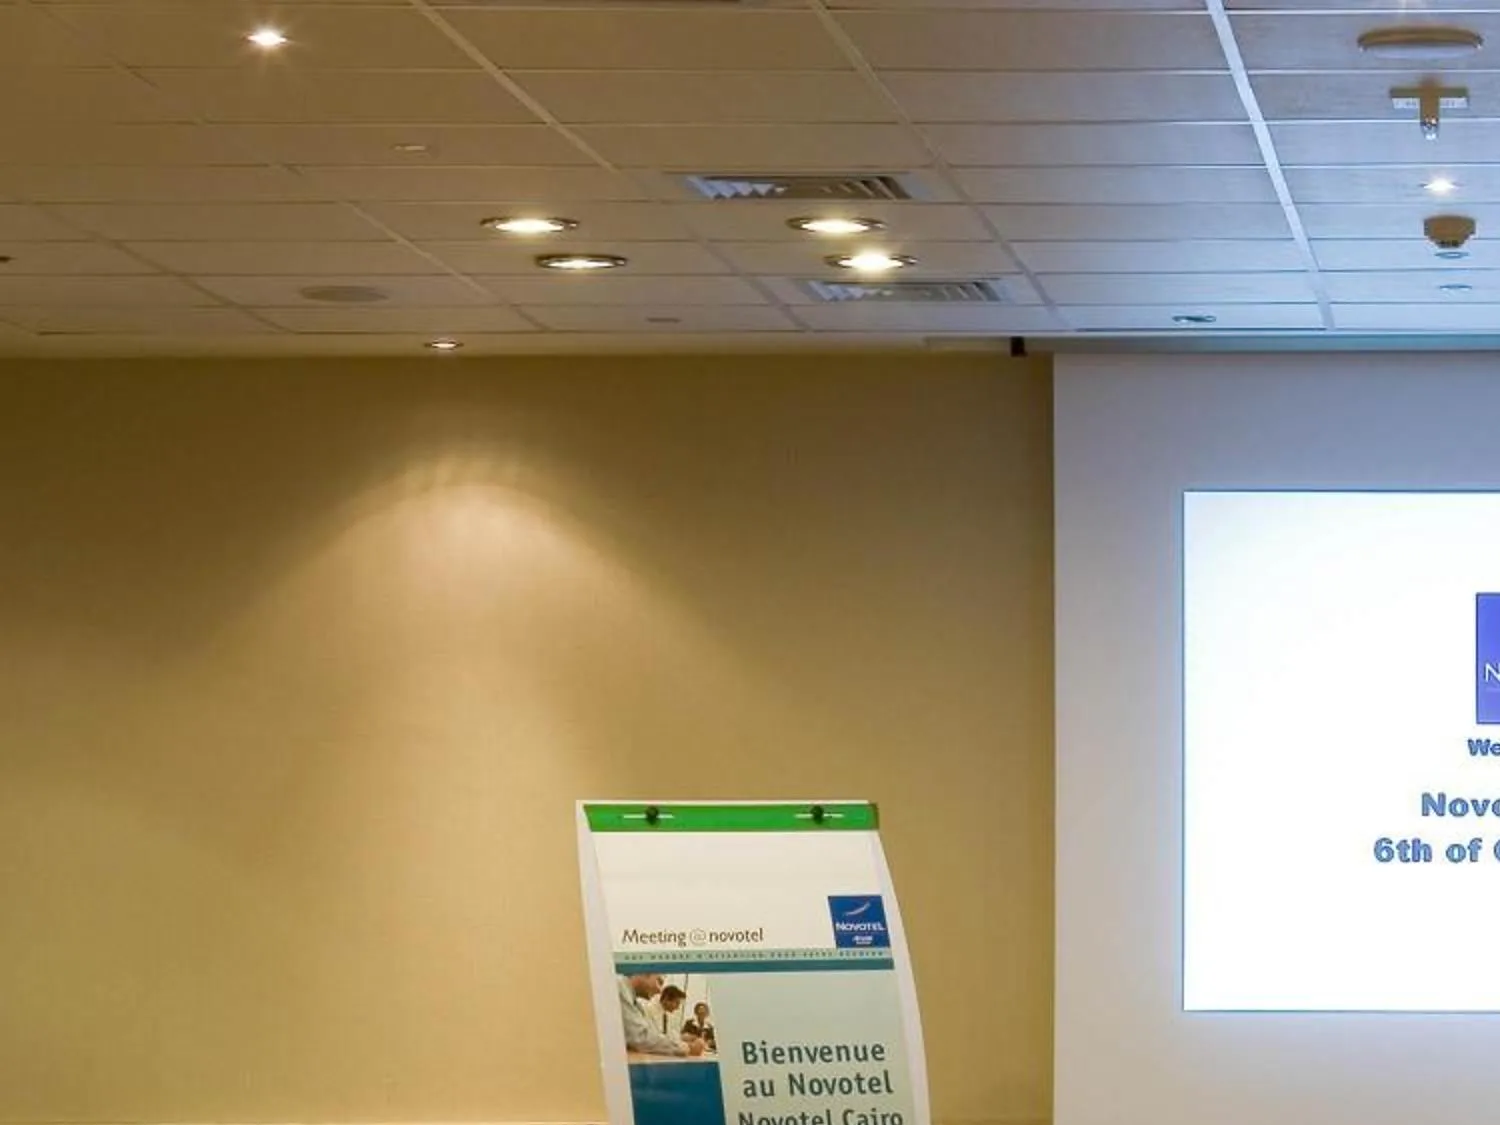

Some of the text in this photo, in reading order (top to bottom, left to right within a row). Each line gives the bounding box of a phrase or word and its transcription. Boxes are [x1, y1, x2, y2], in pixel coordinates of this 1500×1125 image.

[1373, 836, 1433, 864] 6th
[1445, 836, 1483, 864] of
[741, 1040, 886, 1066] Bienvenue
[743, 1069, 894, 1098] au Novotel
